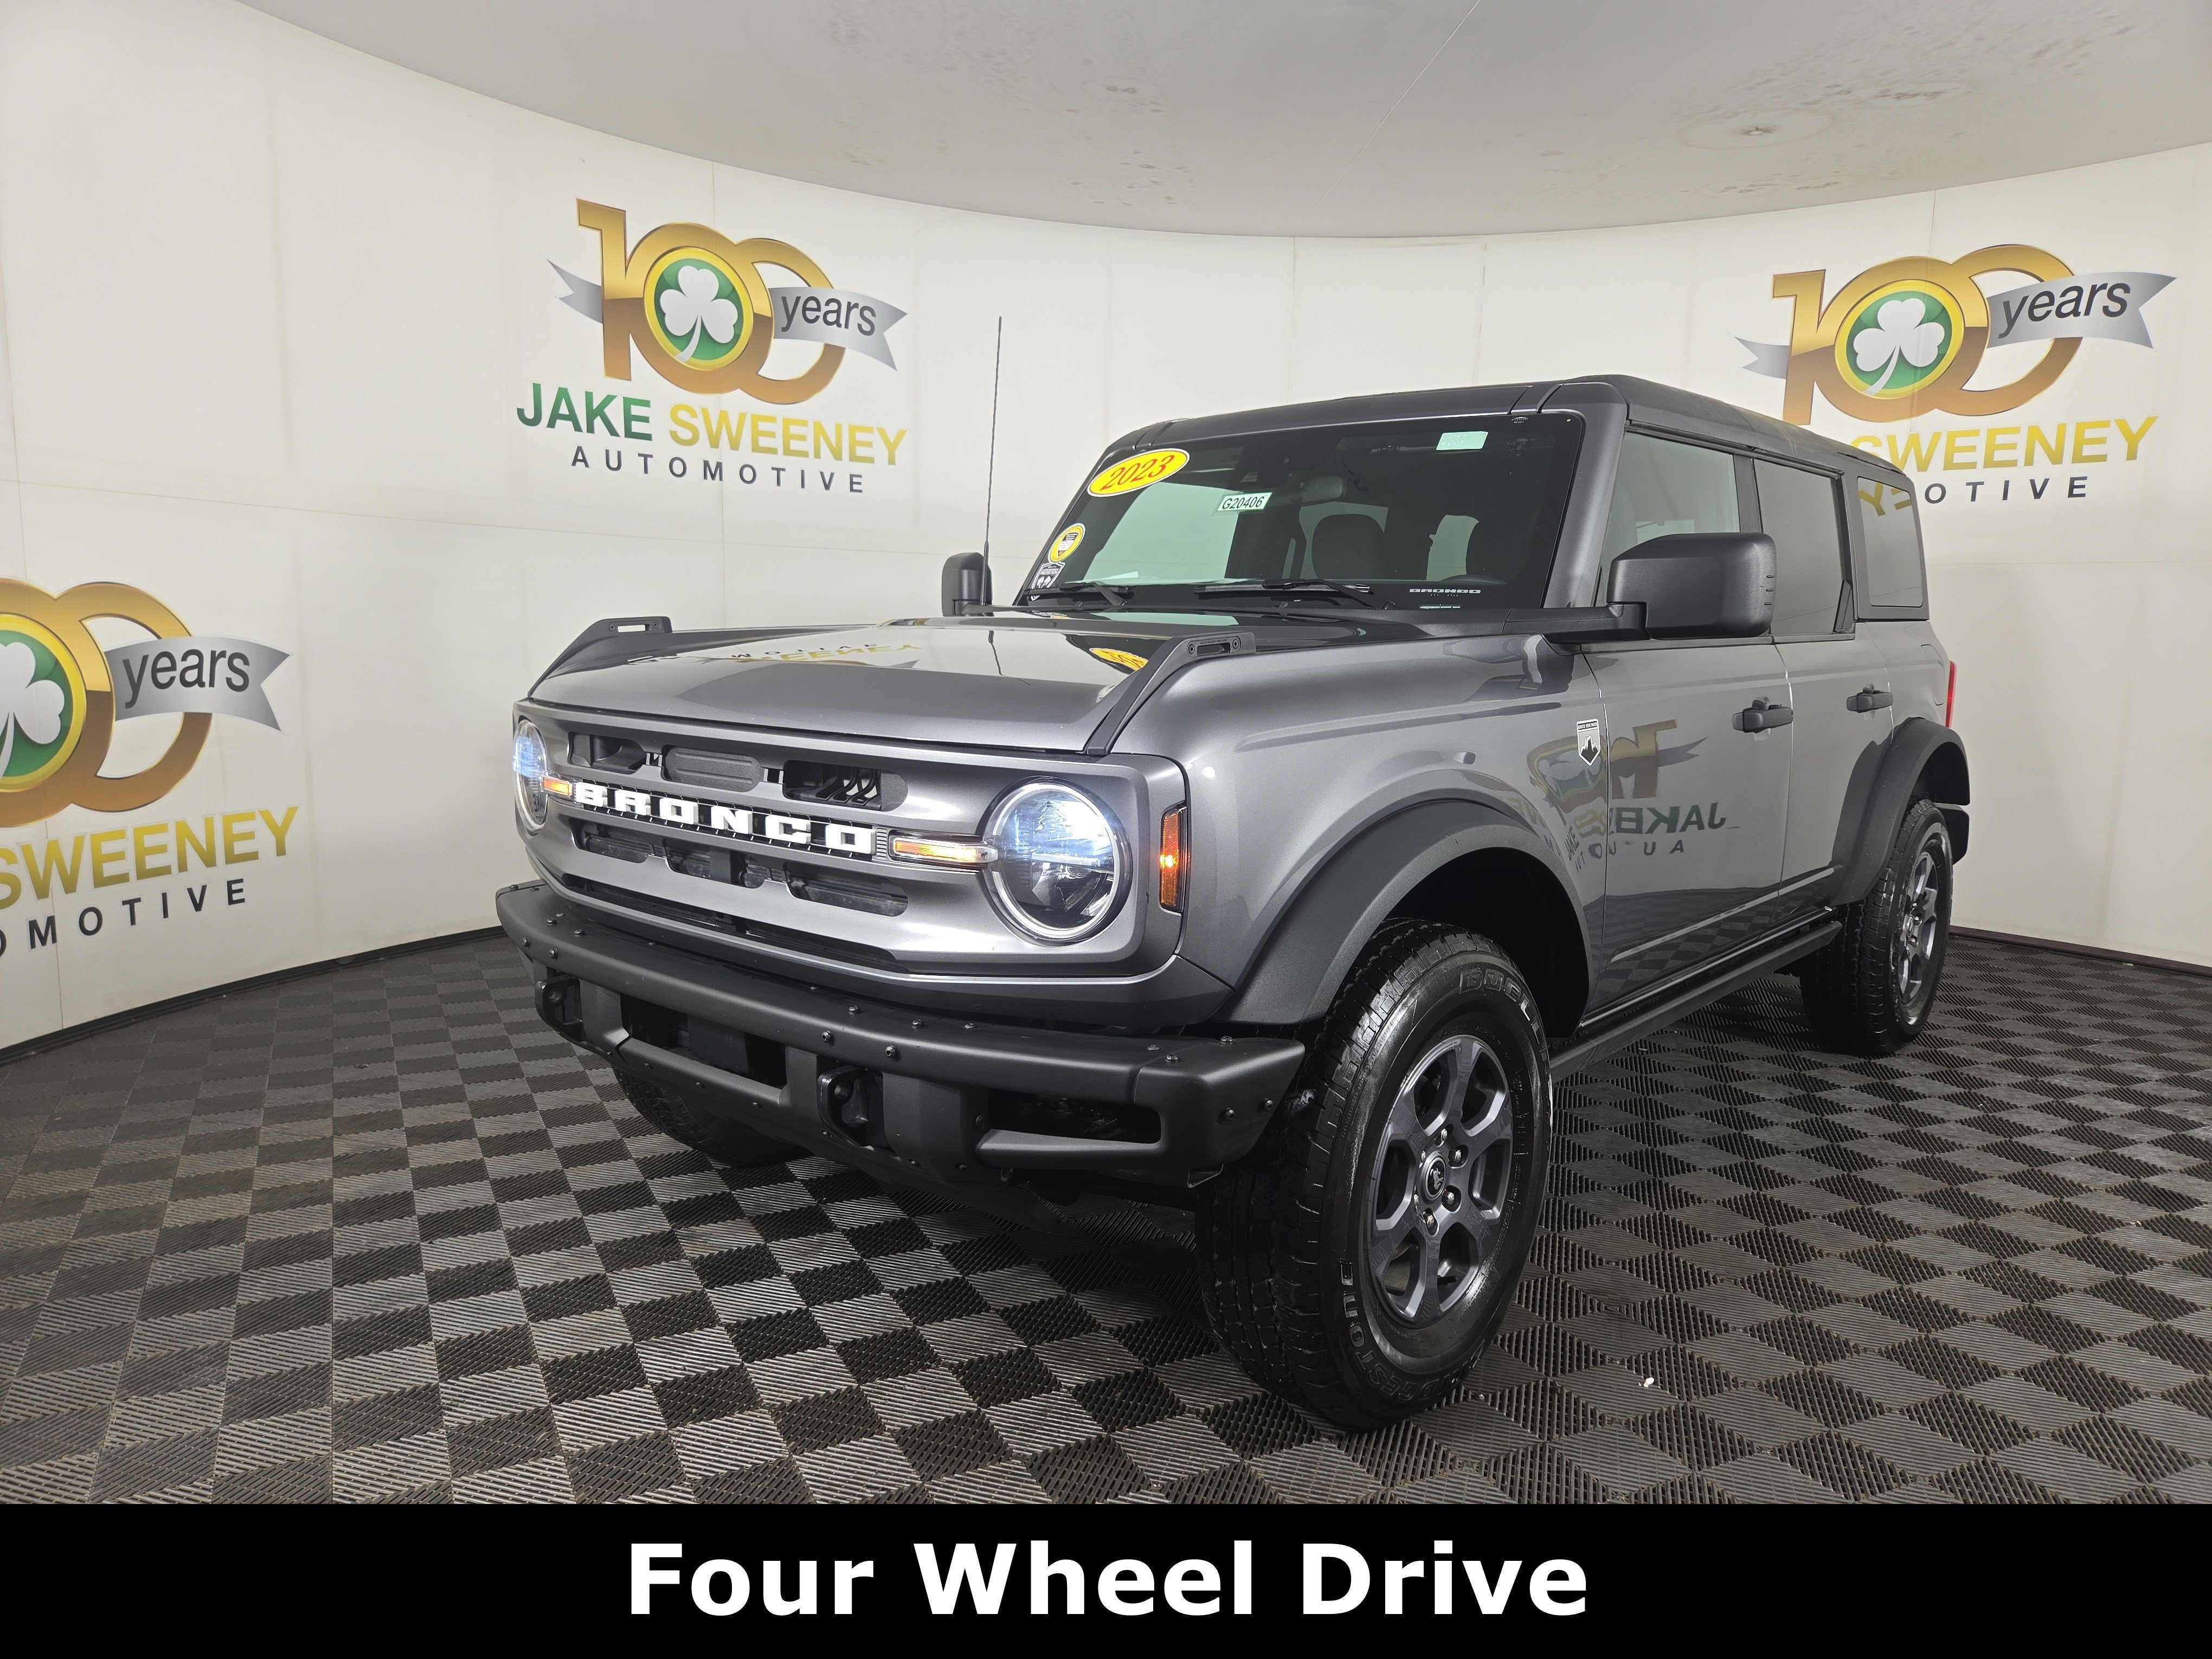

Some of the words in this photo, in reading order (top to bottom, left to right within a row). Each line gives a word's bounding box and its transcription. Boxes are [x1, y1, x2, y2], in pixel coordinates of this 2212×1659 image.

[781, 295, 876, 336] years
[1998, 280, 2130, 339] years
[517, 382, 652, 441] JAKE
[670, 403, 906, 465] SWEENEY
[571, 446, 863, 493] AUTOMOTIVE
[1099, 455, 1175, 491] 2023
[1925, 476, 2088, 504] OTIVE
[1222, 496, 1265, 510] G20406
[123, 648, 250, 709] years
[575, 781, 876, 854] BRONCO
[0, 878, 246, 959] MOTIVE
